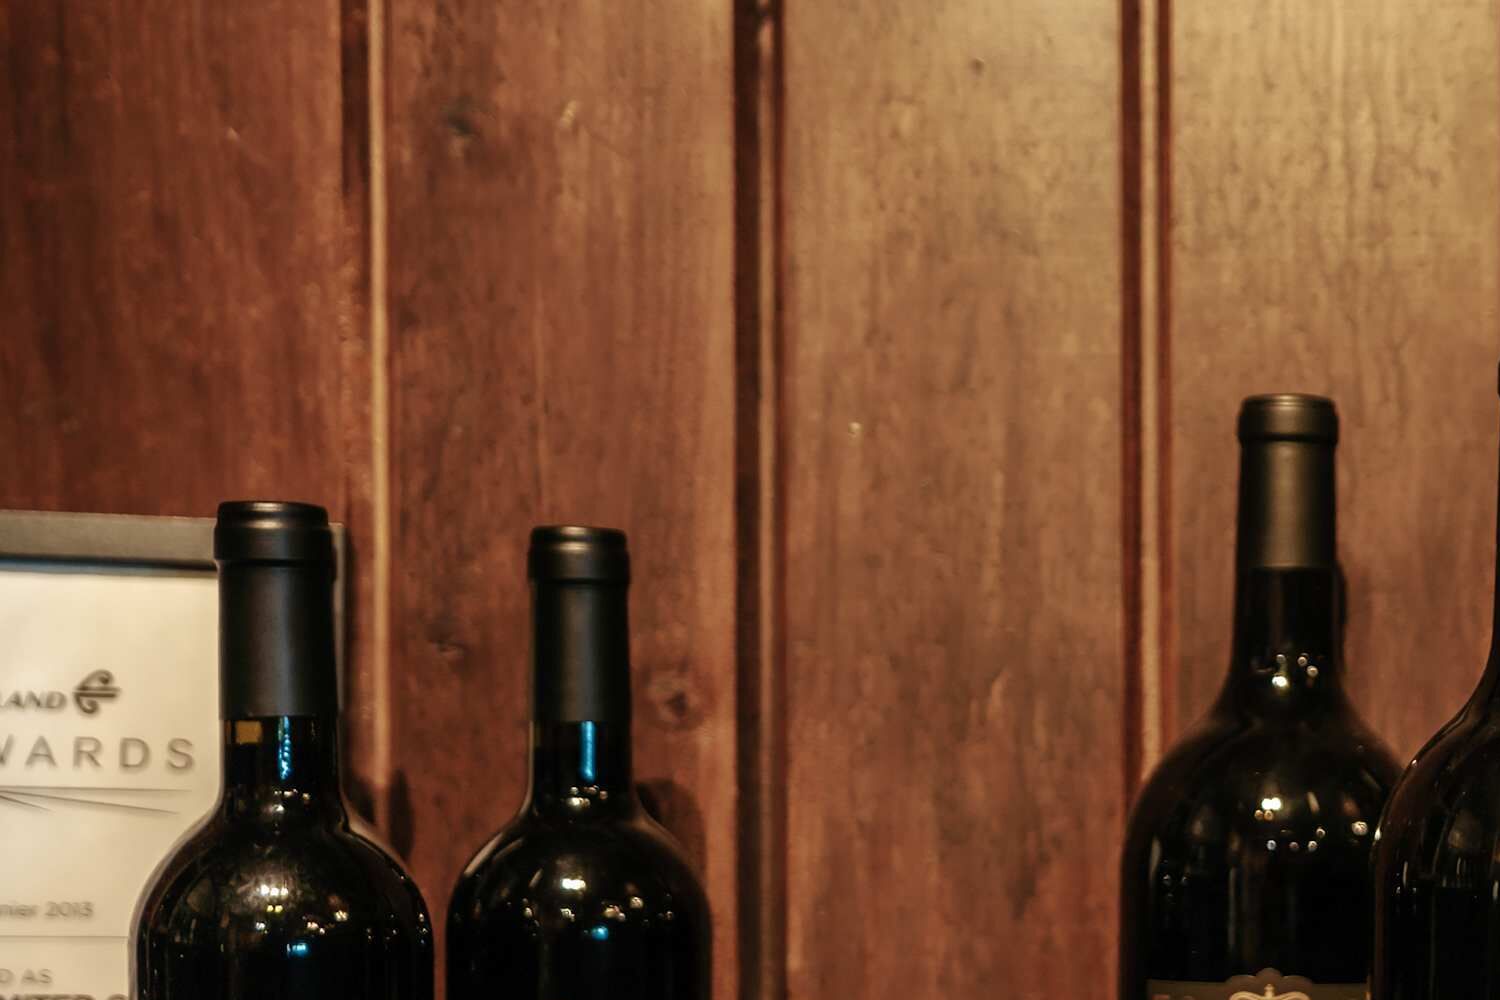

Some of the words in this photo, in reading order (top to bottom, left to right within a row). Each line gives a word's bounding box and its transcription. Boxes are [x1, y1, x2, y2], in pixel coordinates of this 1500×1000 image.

[0, 692, 67, 711] AND
[45, 901, 95, 919] 2013
[22, 967, 53, 985] AS
